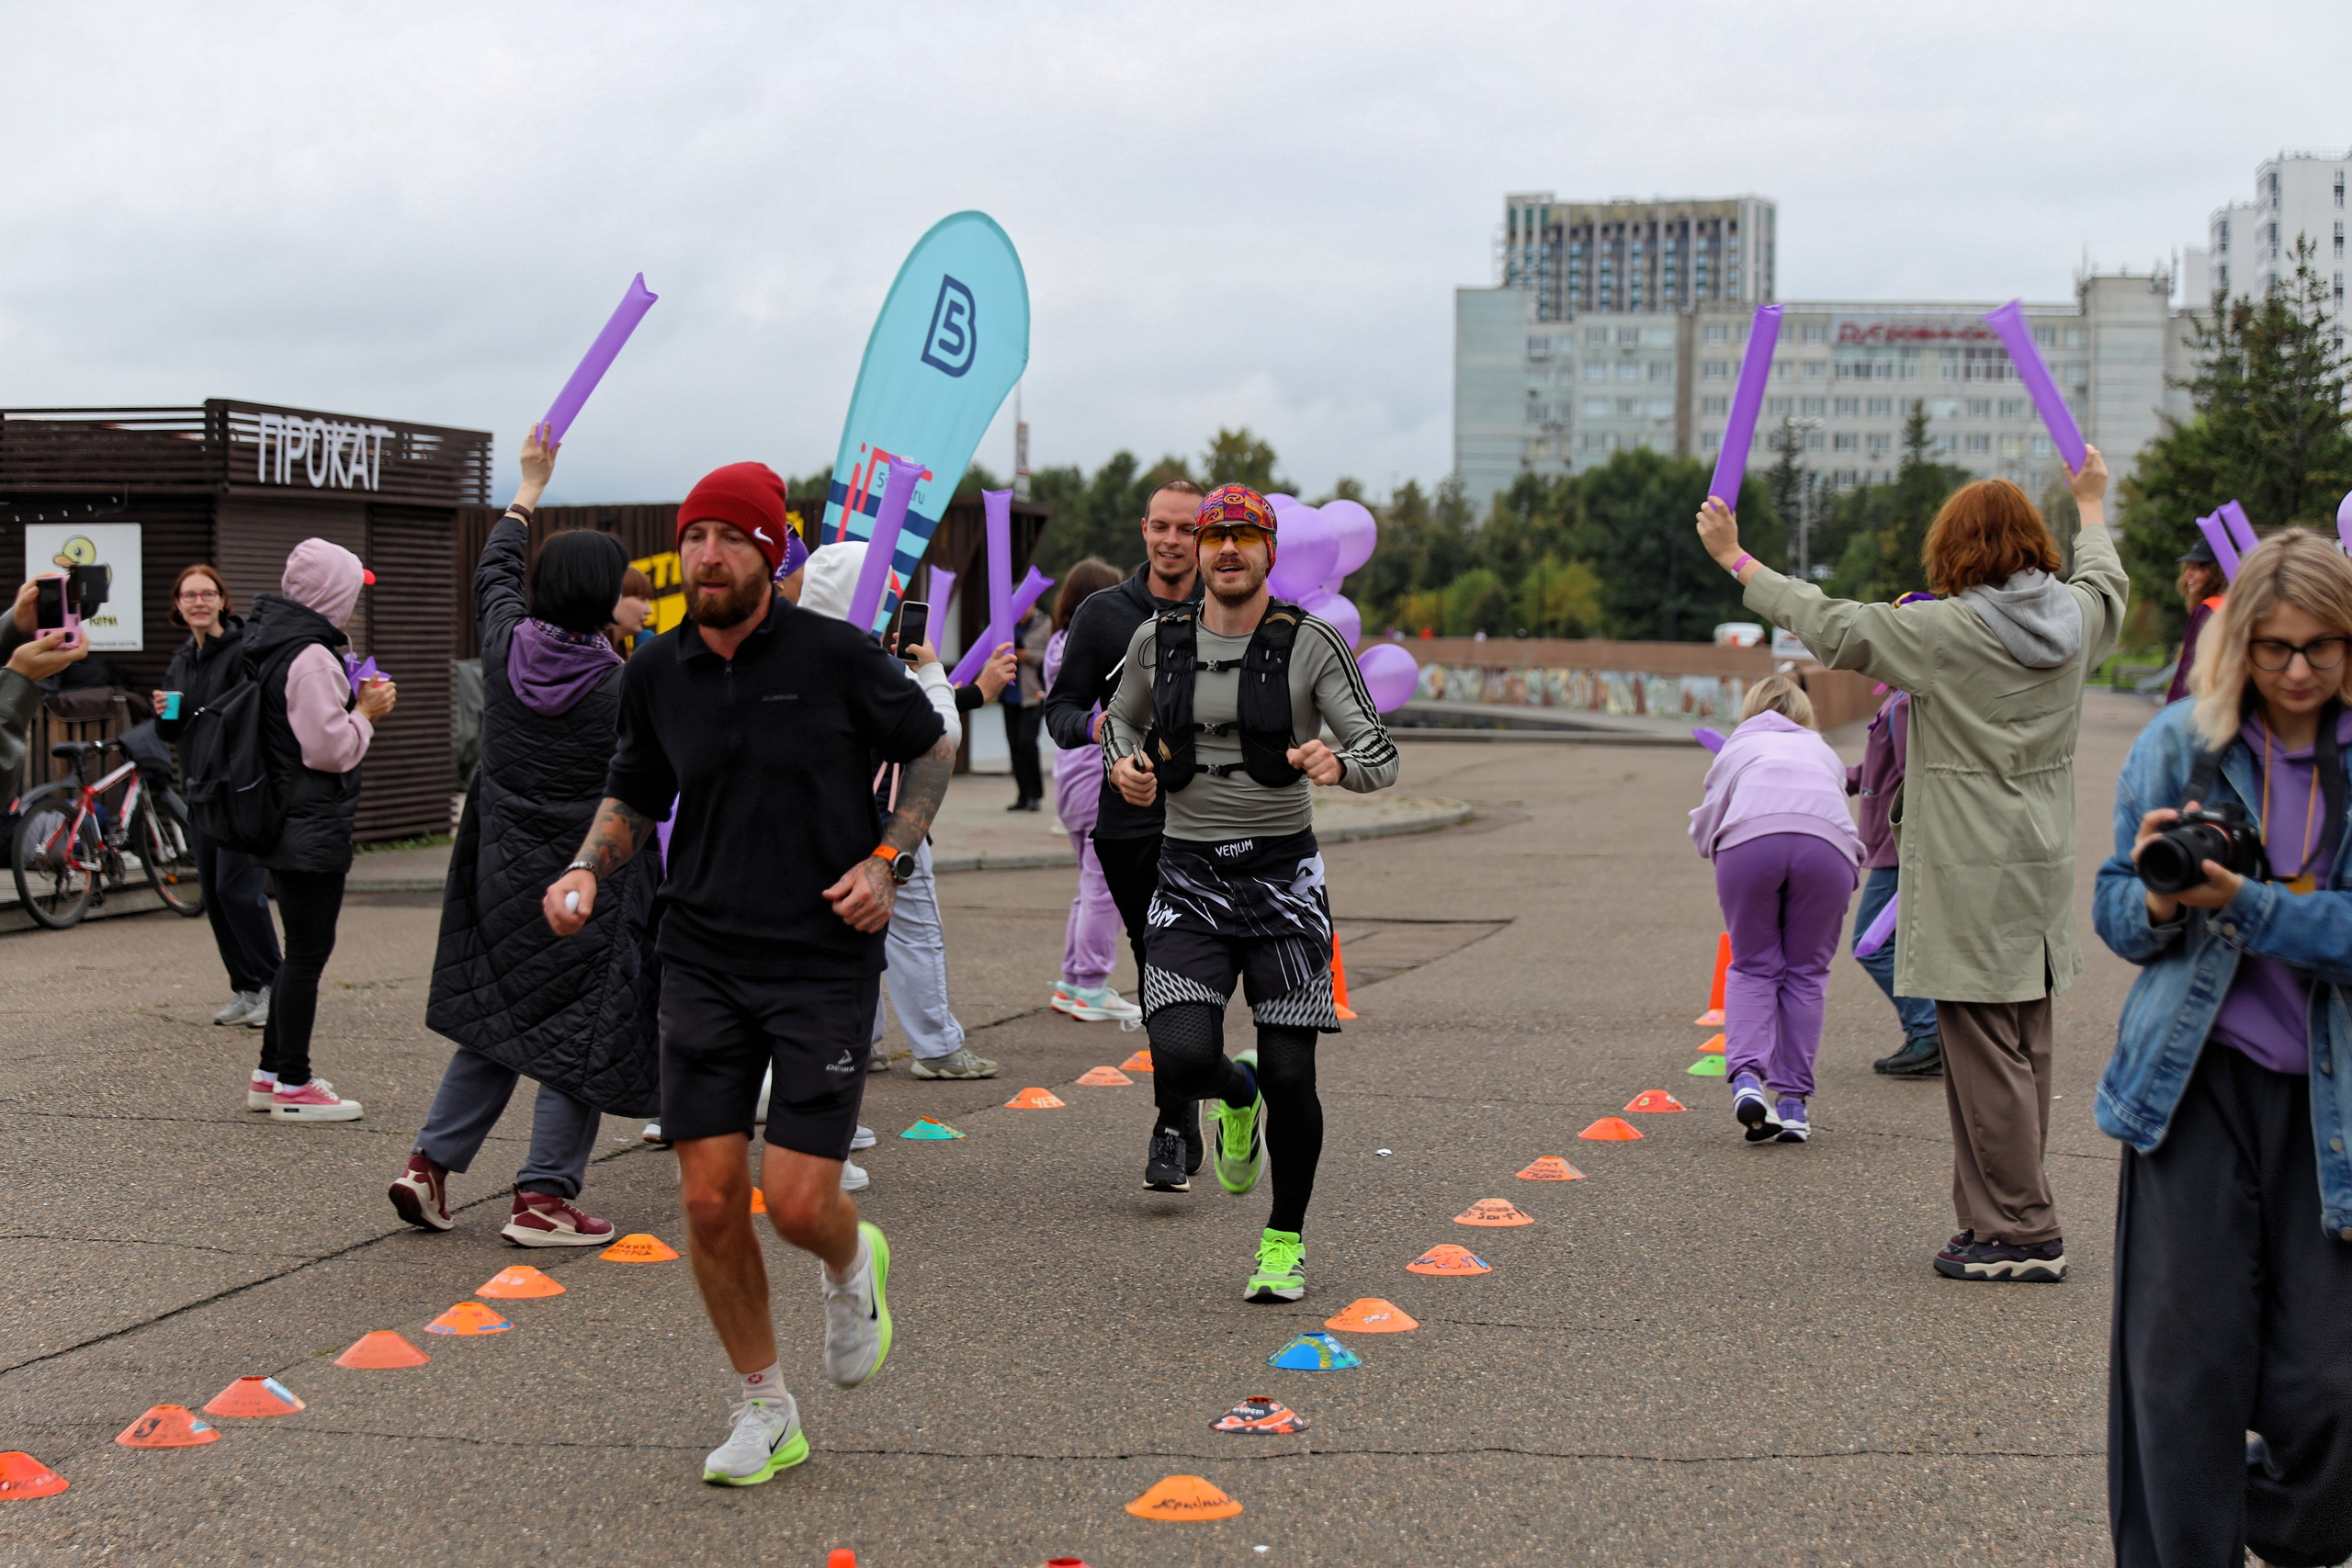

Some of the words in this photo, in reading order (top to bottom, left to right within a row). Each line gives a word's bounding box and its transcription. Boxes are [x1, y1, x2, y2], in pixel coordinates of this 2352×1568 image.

[258, 412, 389, 492] ПРОКАТ
[1215, 839, 1254, 858] VENUM
[826, 1064, 855, 1072] DEMIX
